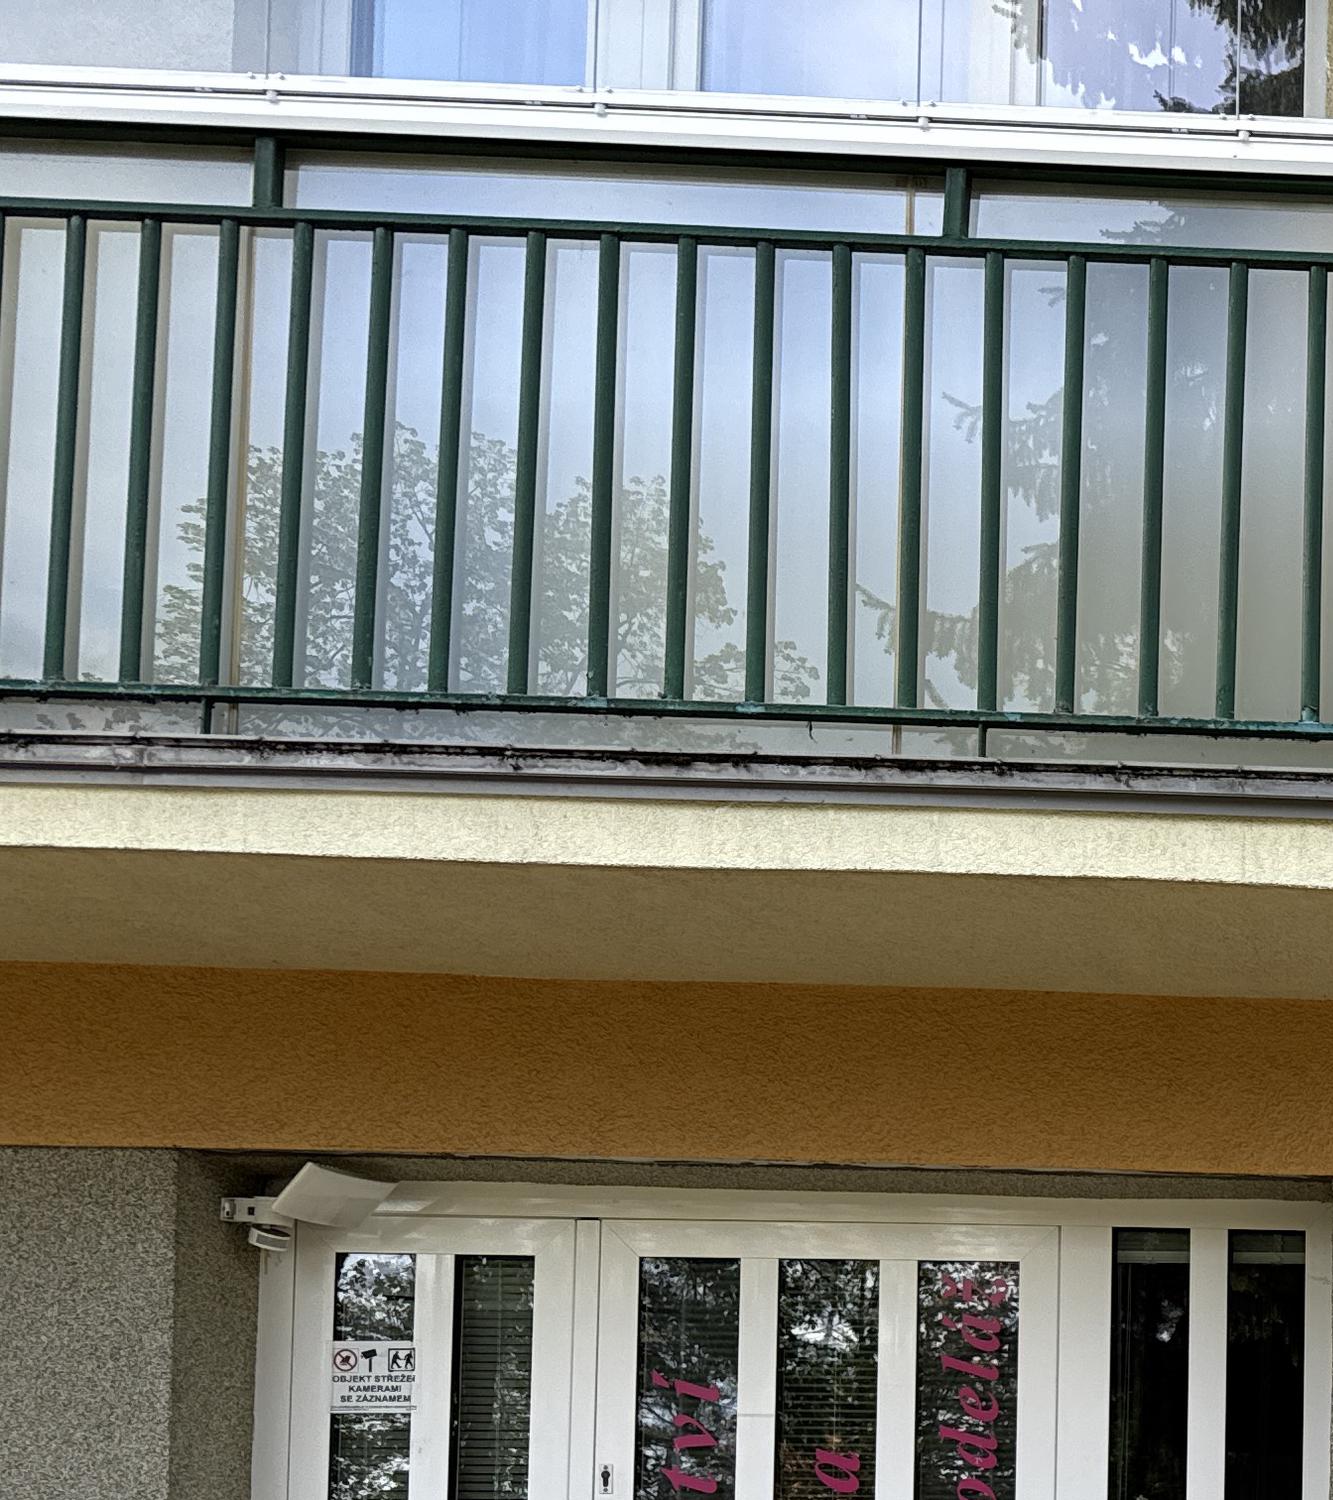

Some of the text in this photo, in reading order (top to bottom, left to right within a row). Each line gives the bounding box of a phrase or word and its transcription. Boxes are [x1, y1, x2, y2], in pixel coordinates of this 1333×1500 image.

[332, 1375, 372, 1383] OBJEKT
[348, 1385, 402, 1393] KAMERAMI
[340, 1395, 354, 1403] SE
